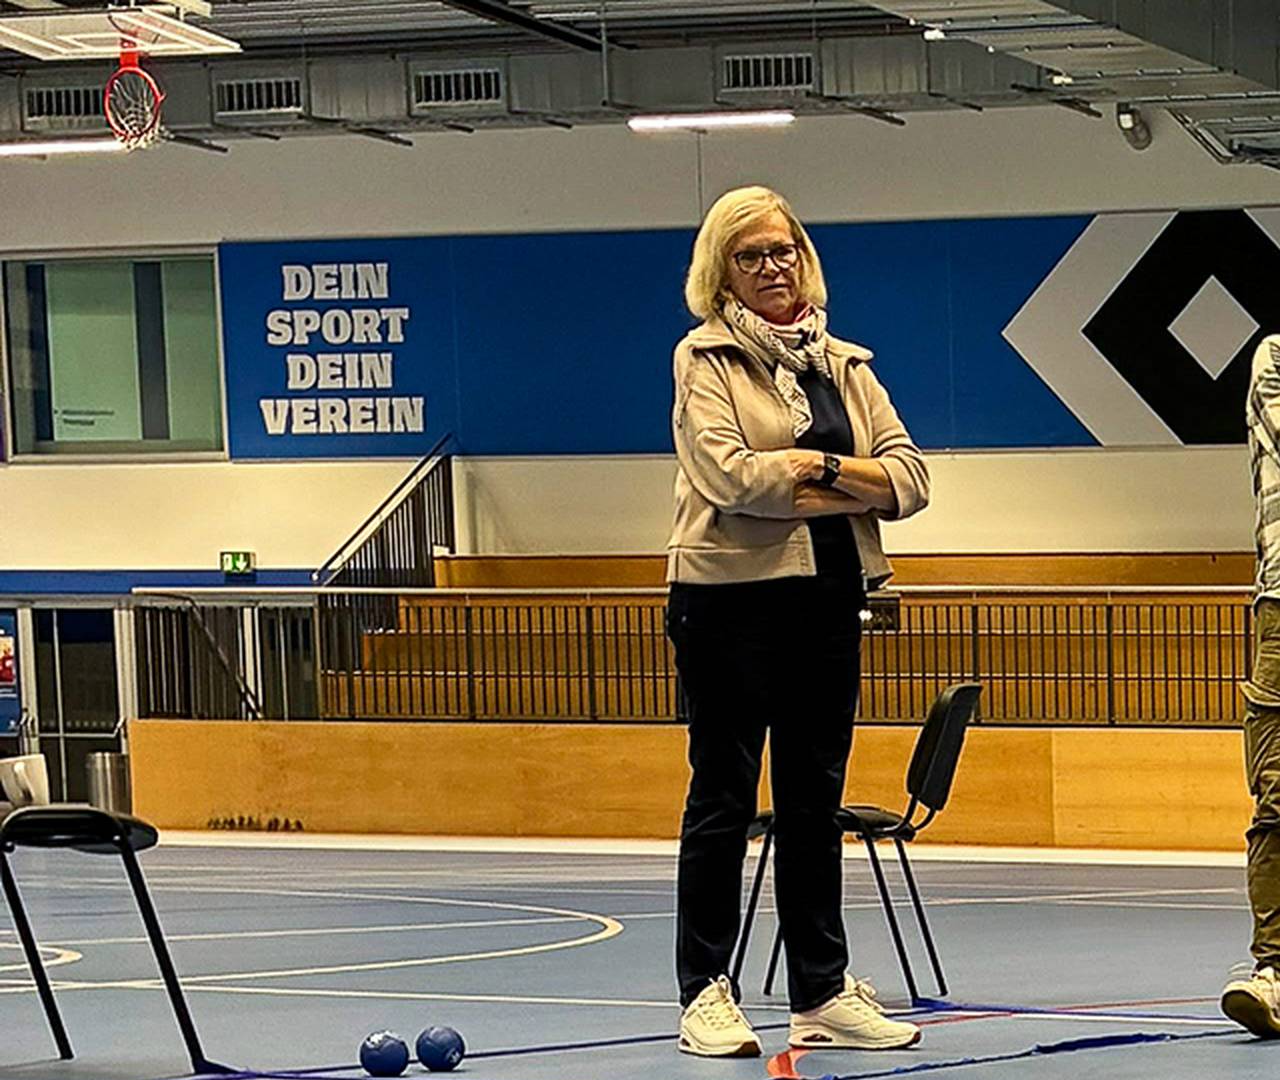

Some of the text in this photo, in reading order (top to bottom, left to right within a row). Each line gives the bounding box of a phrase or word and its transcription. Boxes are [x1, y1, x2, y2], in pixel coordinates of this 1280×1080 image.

[282, 263, 388, 300] DEIN
[266, 308, 409, 345] SPORT
[286, 353, 393, 389] DEIN
[260, 397, 424, 434] VEREIN
